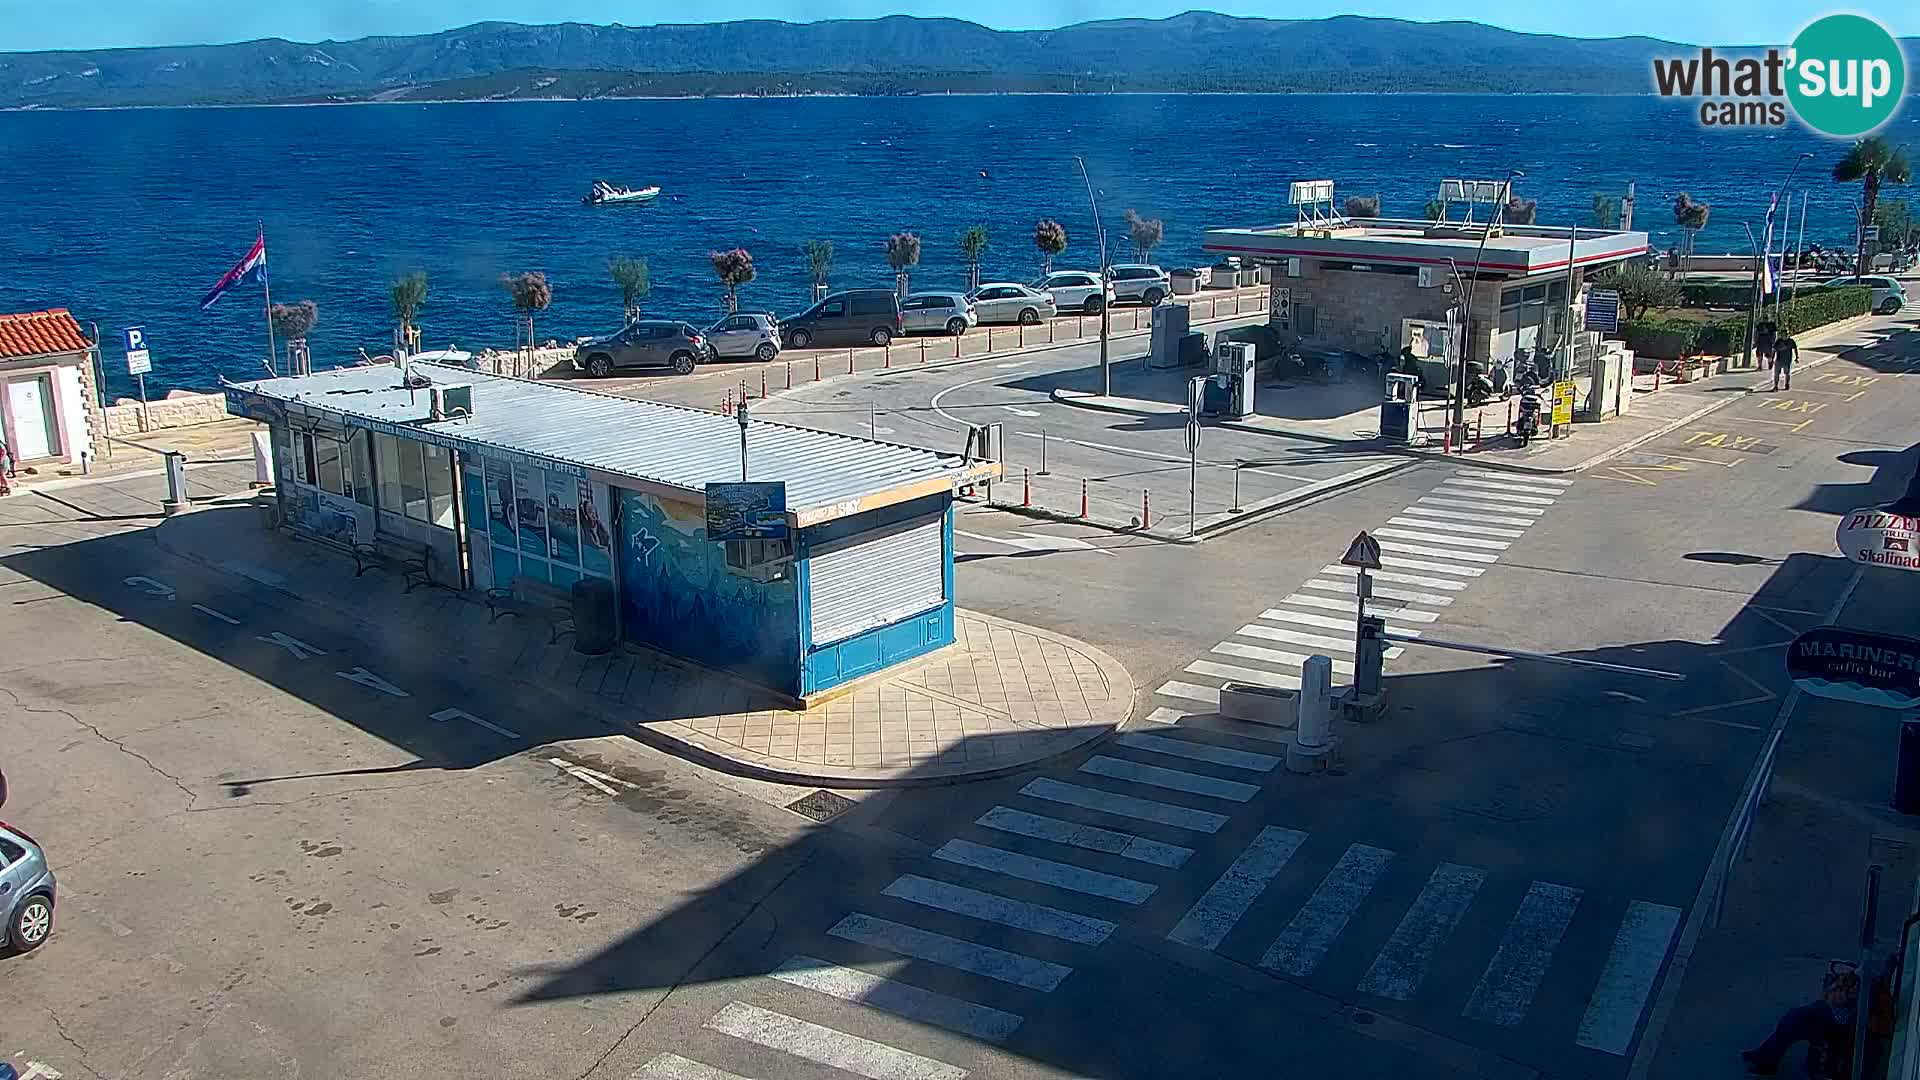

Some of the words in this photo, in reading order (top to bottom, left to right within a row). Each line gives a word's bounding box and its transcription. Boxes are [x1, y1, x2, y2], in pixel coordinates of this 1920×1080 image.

[127, 330, 142, 349] P
[1812, 373, 1880, 387] TAXI
[1757, 398, 1828, 413] TAXI
[1684, 431, 1764, 450] TAXI
[528, 457, 553, 471] TICKET
[555, 464, 582, 476] OFFICE
[1880, 529, 1916, 540] GRILL
[1826, 660, 1865, 675] caffe
[1869, 664, 1897, 679] bar
